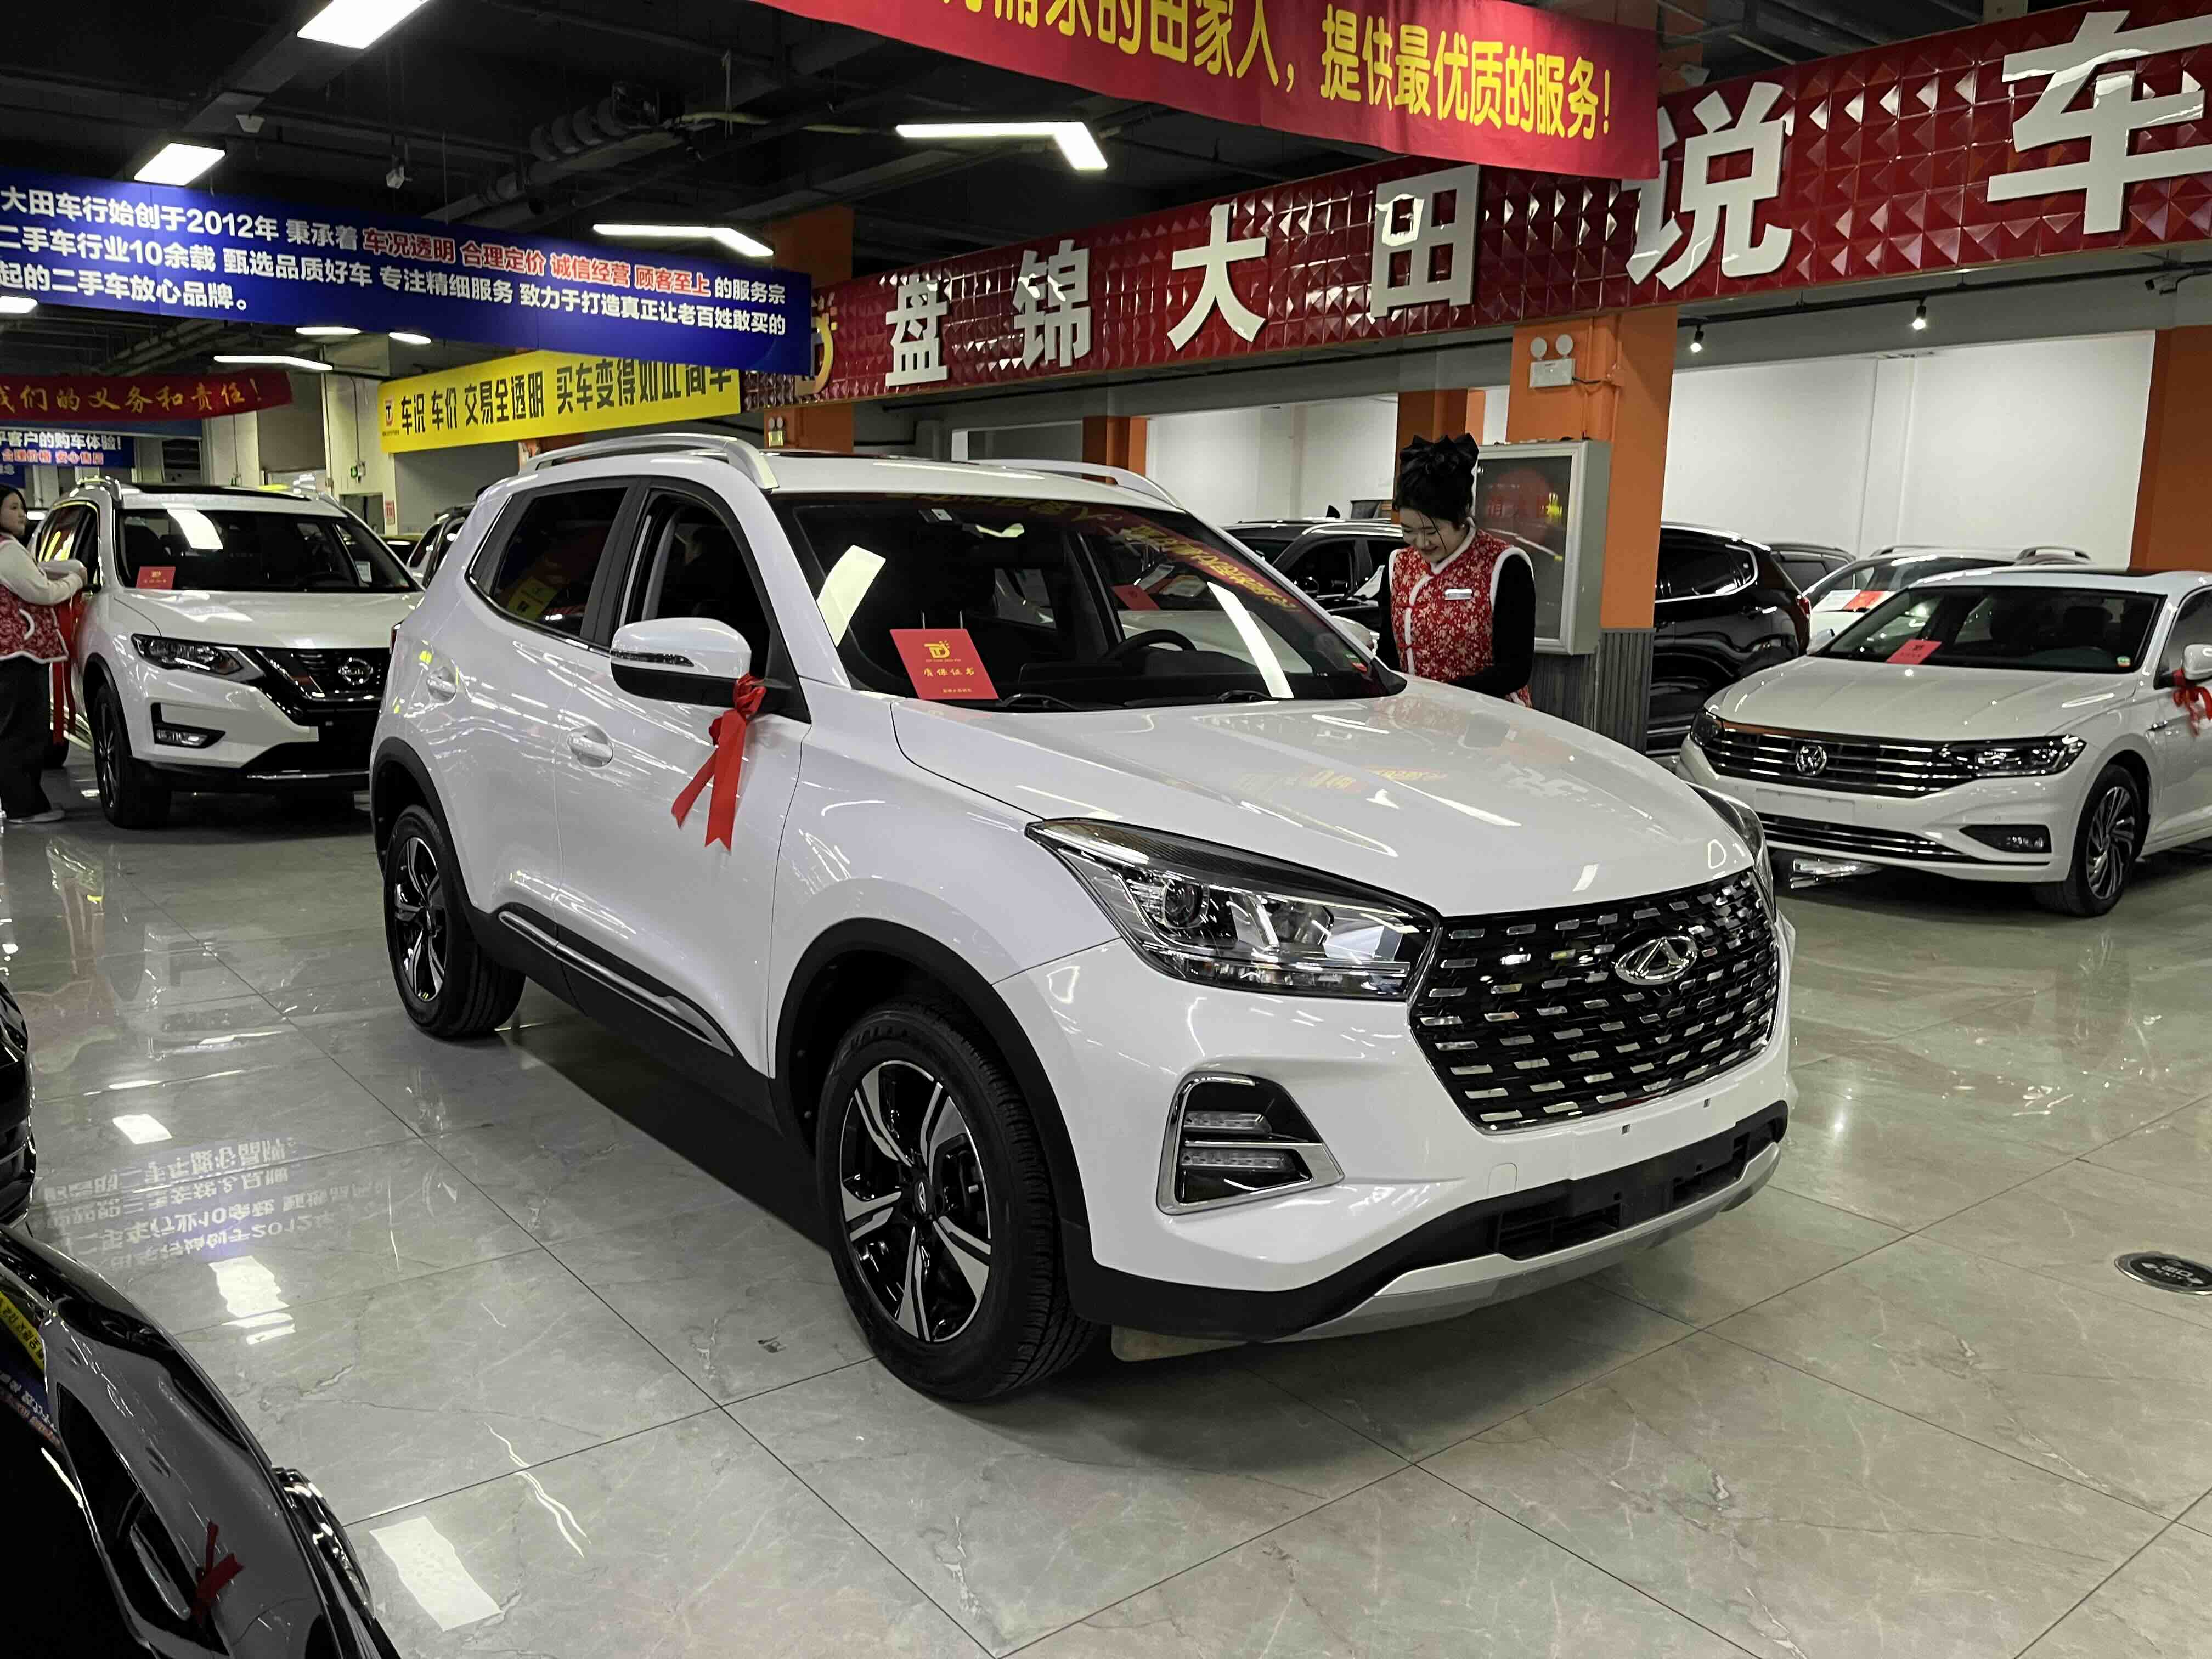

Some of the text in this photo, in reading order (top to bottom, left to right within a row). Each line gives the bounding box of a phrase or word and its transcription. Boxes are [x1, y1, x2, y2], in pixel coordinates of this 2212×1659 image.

[943, 0, 1611, 140] 田家人，提供最优质的服务！
[0, 224, 786, 336] 二手车行业10余载 甄选品质好车 专注精细服务 致力于打造真正让老百姓敢买的
[1, 185, 786, 304] 大田车行始创于2012年 秉承着 车况透明 合理定价 诚信经营 顾客至上 的服务宗
[401, 394, 426, 435] 车况
[431, 387, 458, 431] 车价
[464, 370, 545, 427] 交易全透明
